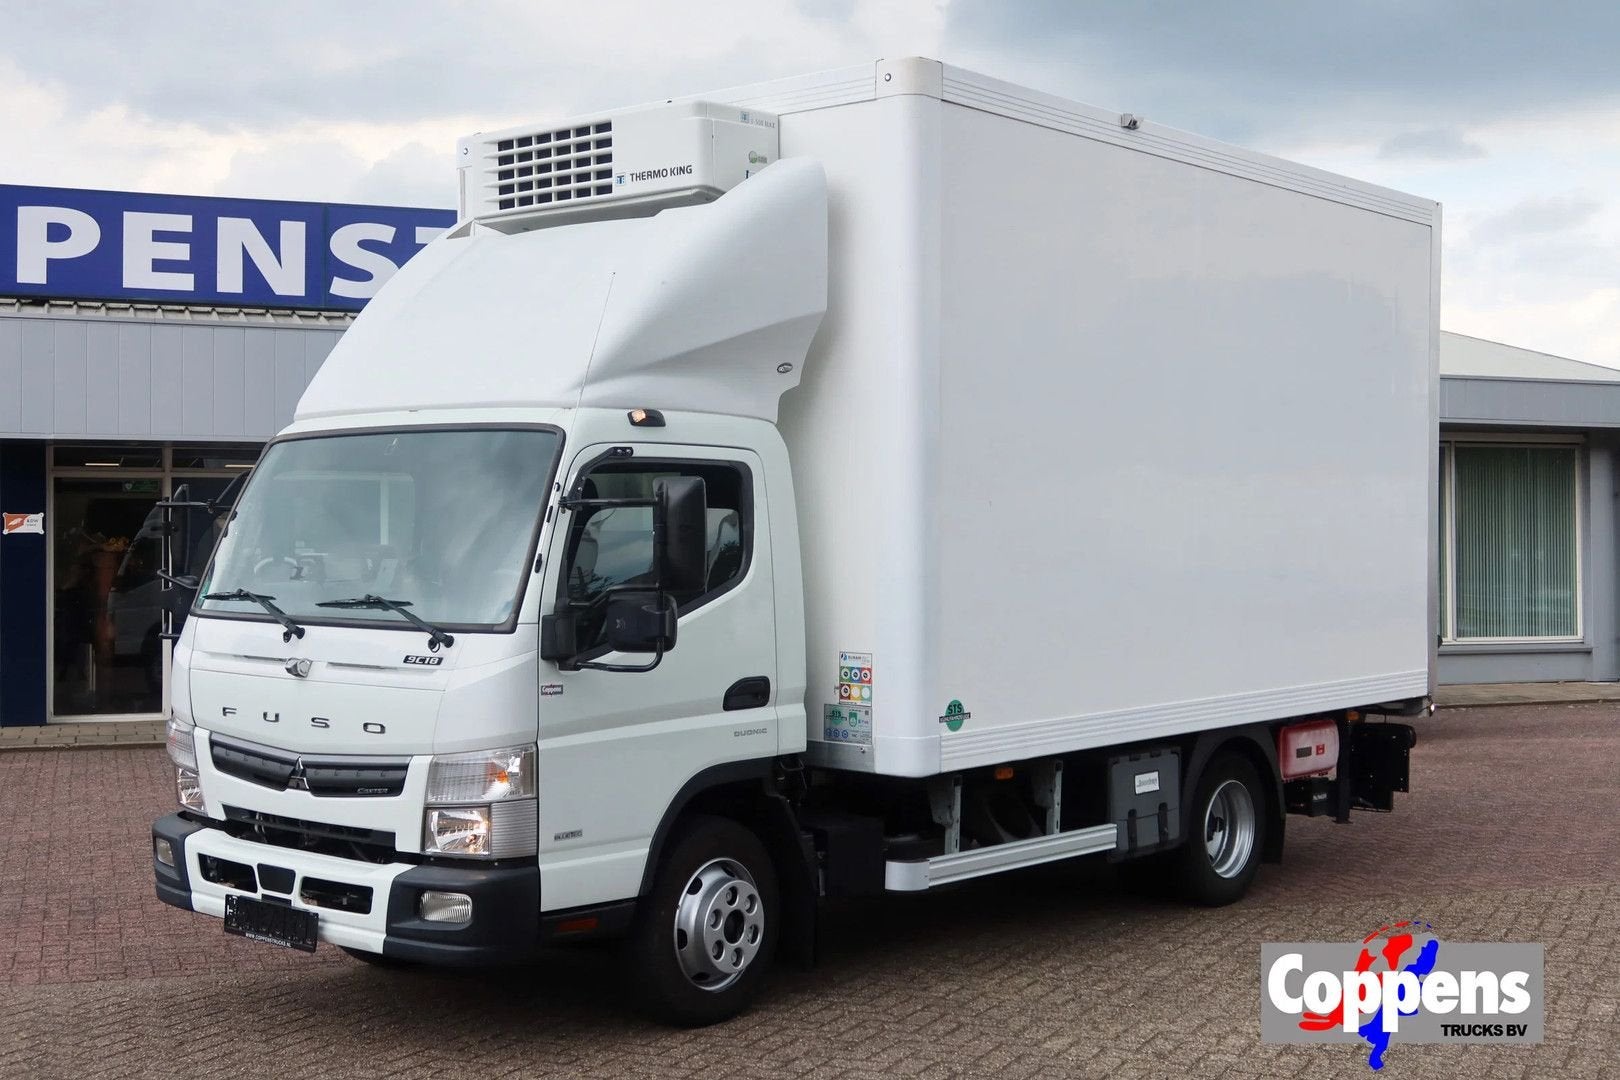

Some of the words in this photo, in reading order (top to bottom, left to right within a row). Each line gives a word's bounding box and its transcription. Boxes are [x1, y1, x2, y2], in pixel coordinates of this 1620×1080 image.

[630, 168, 668, 182] THERMO
[669, 165, 693, 177] KING
[405, 655, 439, 665] 9C18
[947, 702, 962, 715] STS
[222, 706, 386, 734] FUSO
[733, 728, 768, 737] DUONIC
